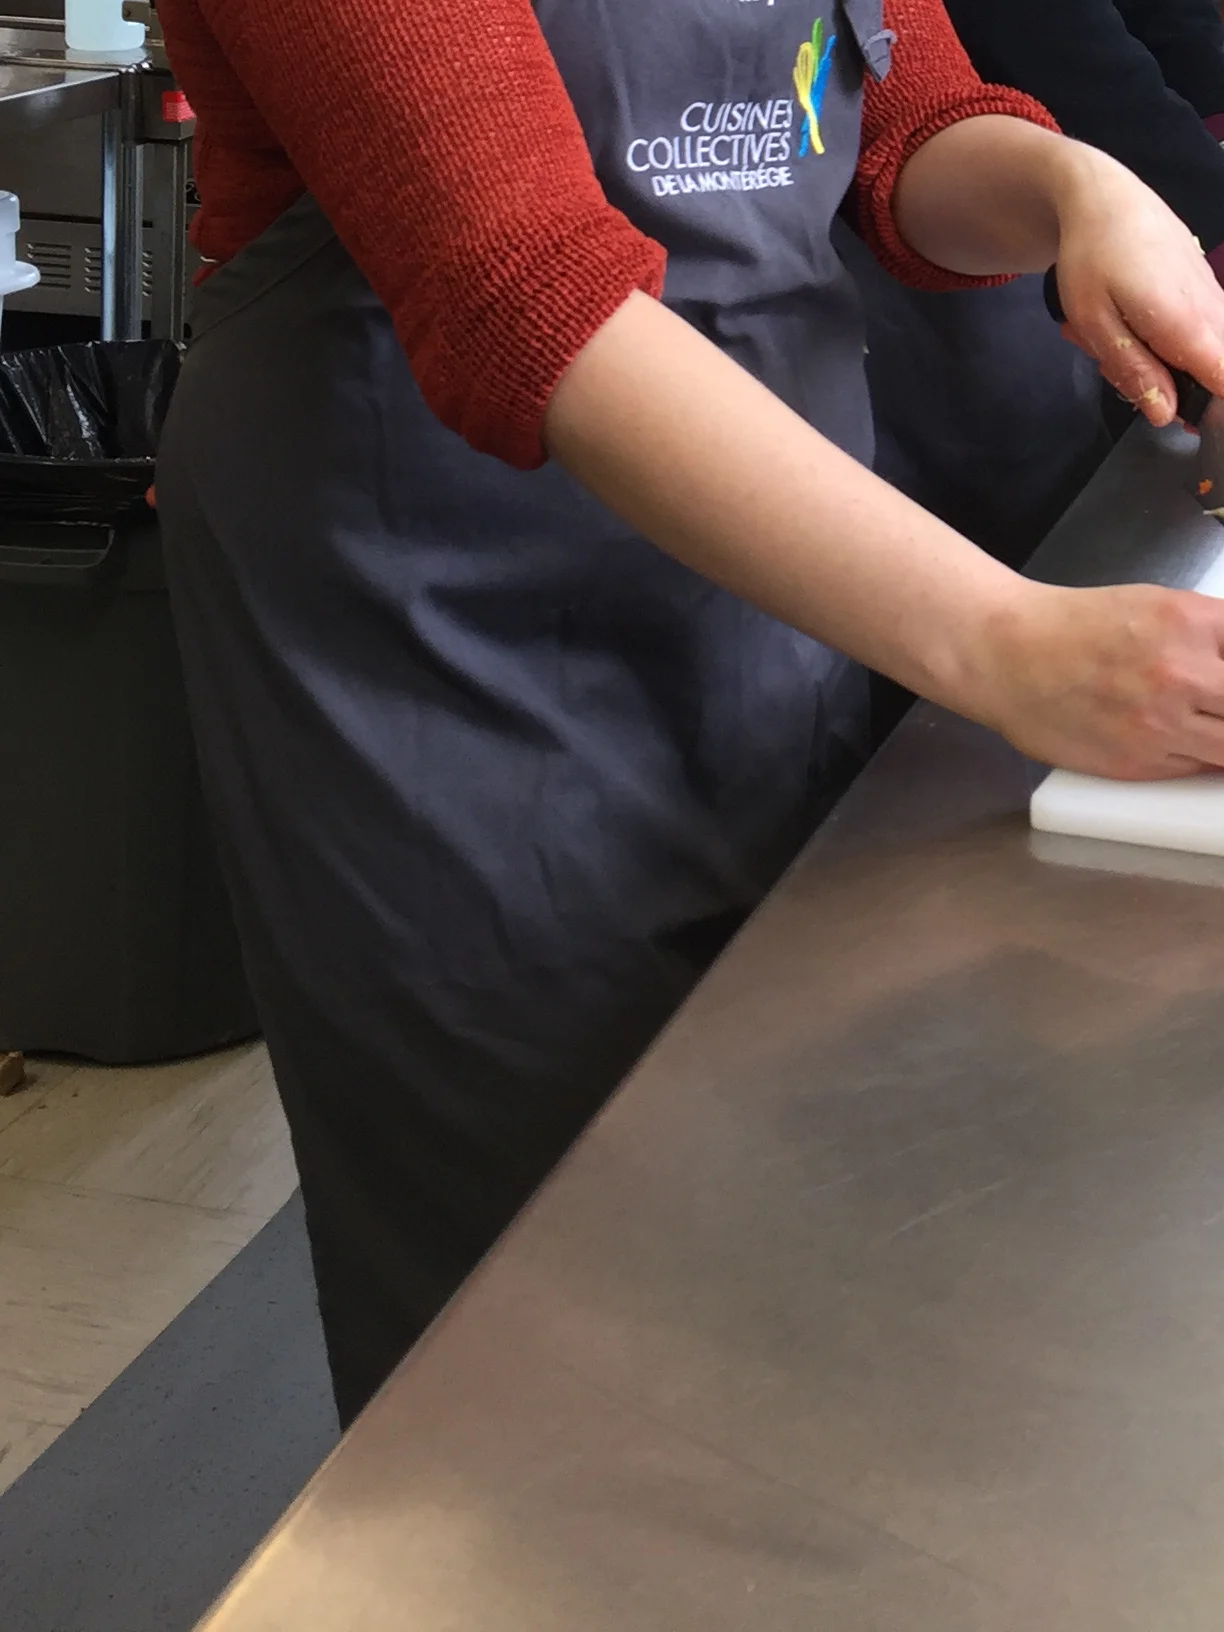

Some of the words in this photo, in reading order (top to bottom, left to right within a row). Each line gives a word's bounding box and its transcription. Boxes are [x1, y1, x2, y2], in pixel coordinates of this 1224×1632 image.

[680, 99, 793, 133] CUISINES
[626, 132, 792, 172] COLLECTIVES
[652, 174, 681, 197] DE
